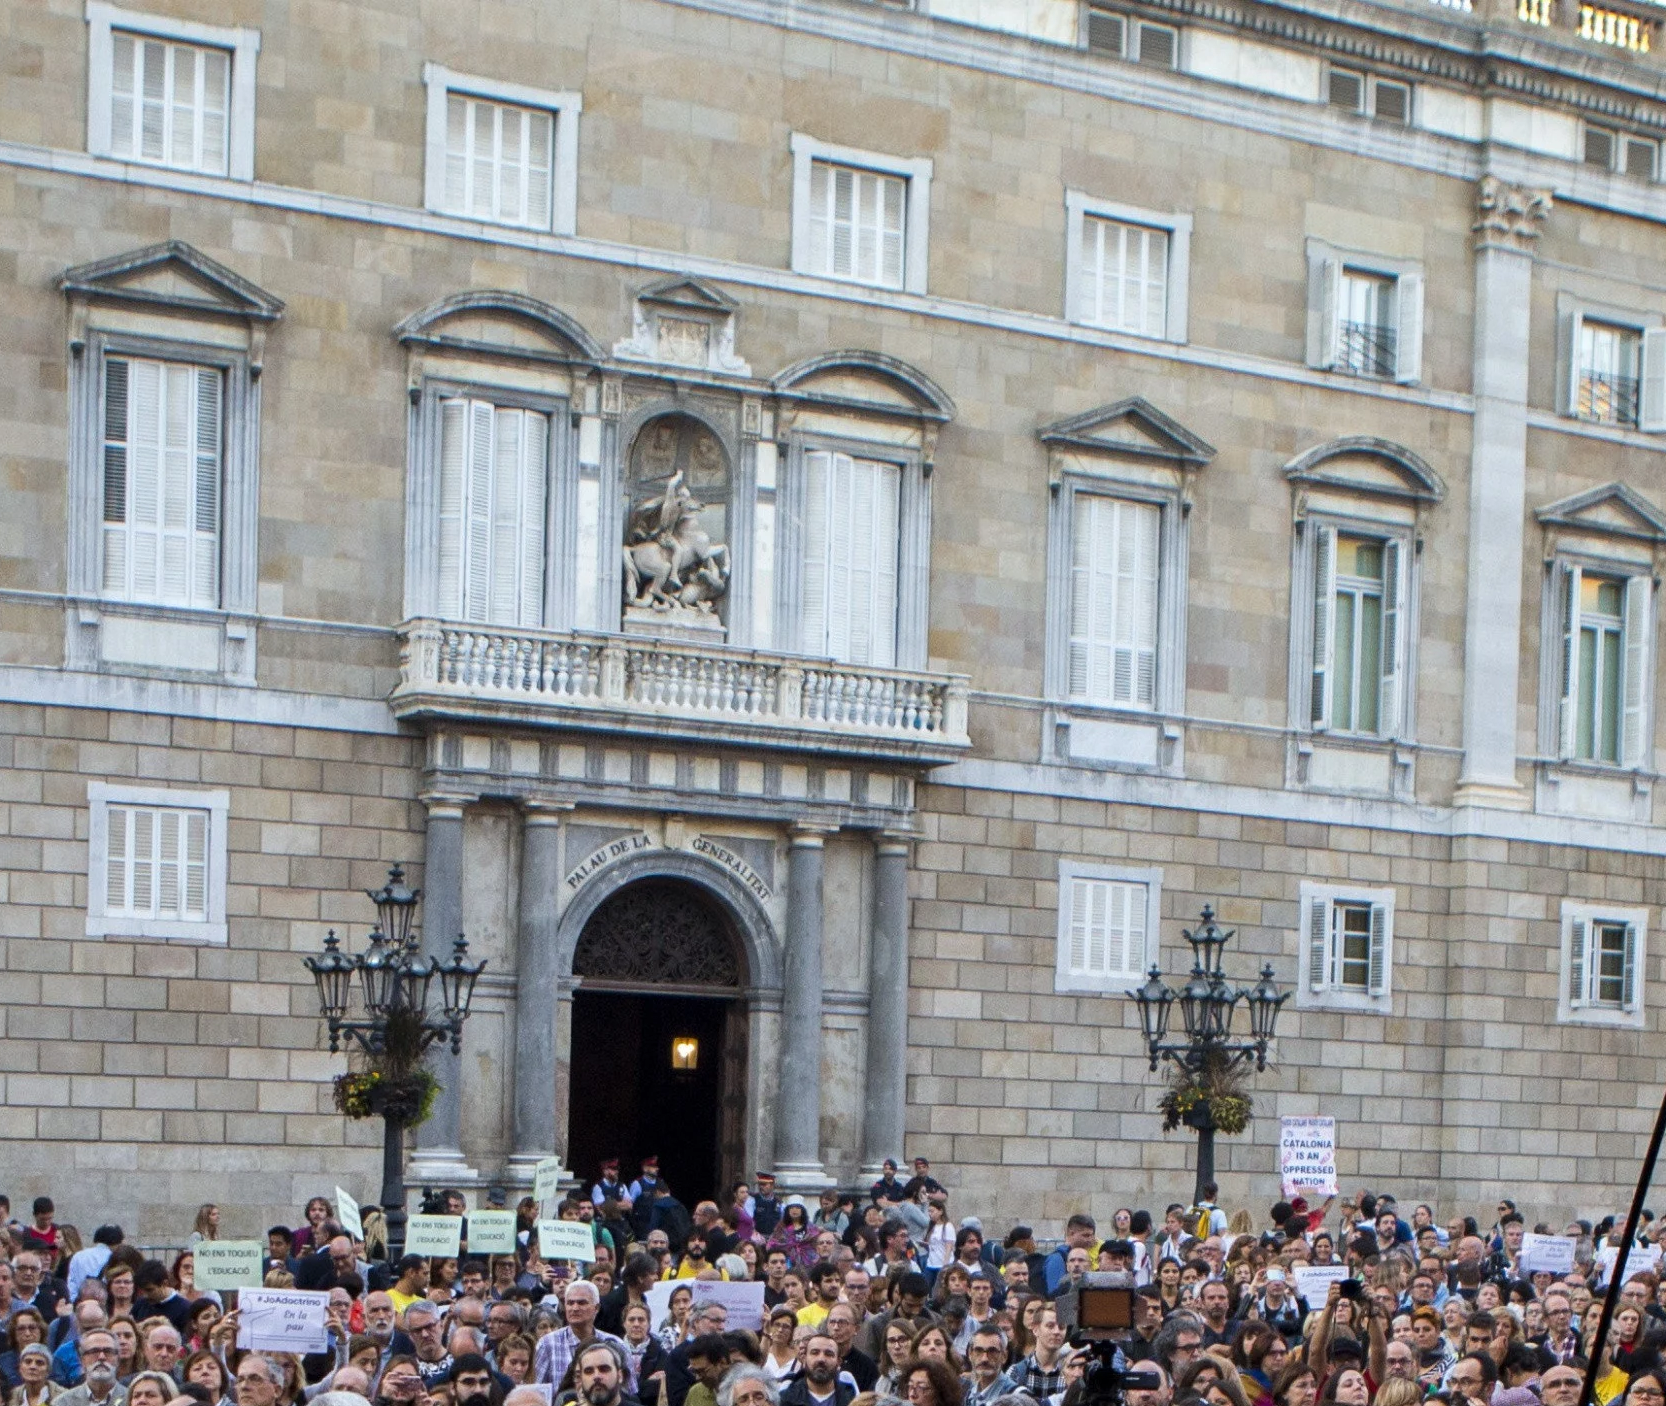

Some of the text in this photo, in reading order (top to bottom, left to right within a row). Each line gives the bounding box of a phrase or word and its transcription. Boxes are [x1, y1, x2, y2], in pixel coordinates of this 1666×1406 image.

[567, 835, 773, 901] PALAU DE LA GENERALITAT
[1283, 1139, 1332, 1147] CATALONIA
[1283, 1166, 1333, 1174] OPPRESSED
[212, 1250, 226, 1258] ENS
[228, 1249, 259, 1258] TOQUEU
[283, 1310, 308, 1320] En la
[285, 1324, 304, 1332] pau
